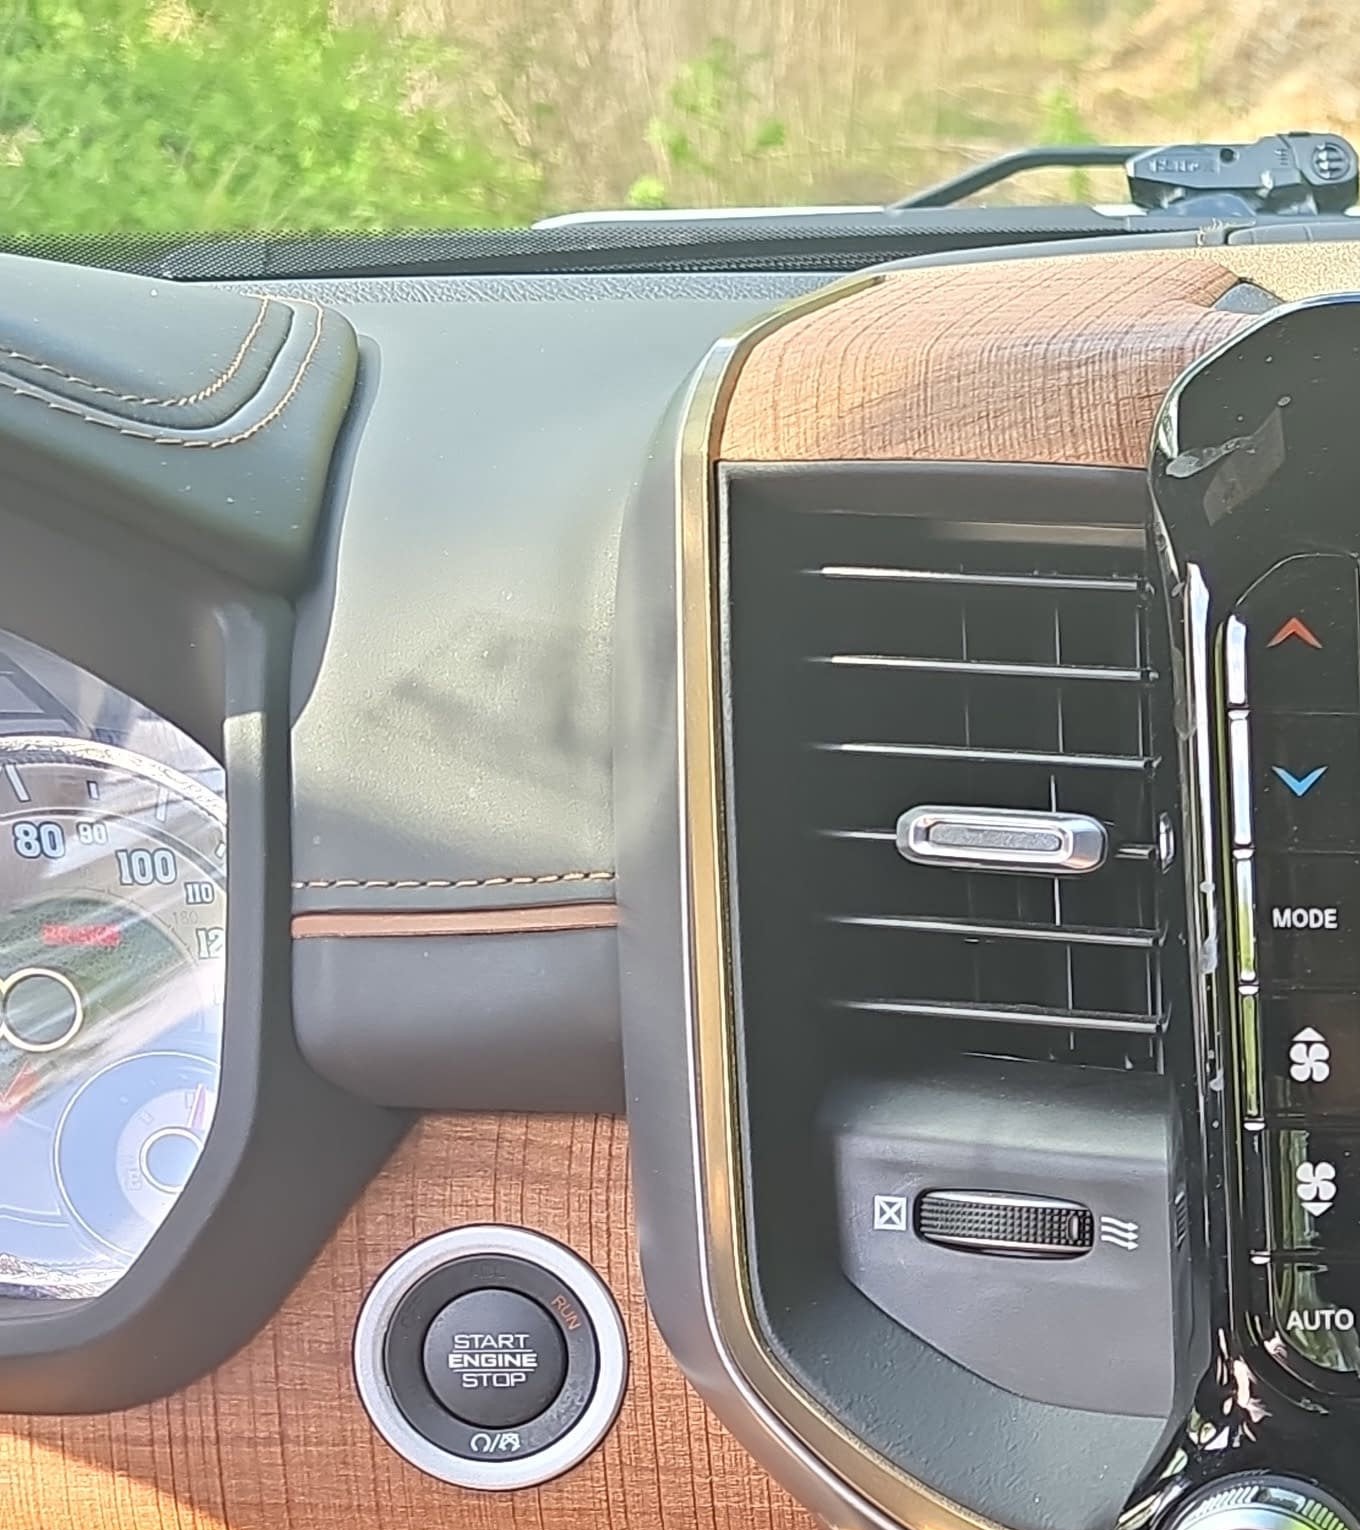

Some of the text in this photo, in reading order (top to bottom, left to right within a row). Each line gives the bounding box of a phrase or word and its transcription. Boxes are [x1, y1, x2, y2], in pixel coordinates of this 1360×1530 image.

[12, 821, 66, 859] 80
[76, 822, 108, 845] 90
[115, 848, 177, 885] 100
[184, 881, 214, 904] 110
[1272, 906, 1338, 930] MODE
[196, 927, 225, 959] 12
[551, 1295, 581, 1330] RUN
[1286, 1308, 1354, 1331] AUTO
[454, 1334, 530, 1349] START
[448, 1352, 538, 1368] ENGINE
[462, 1373, 526, 1388] STOP
